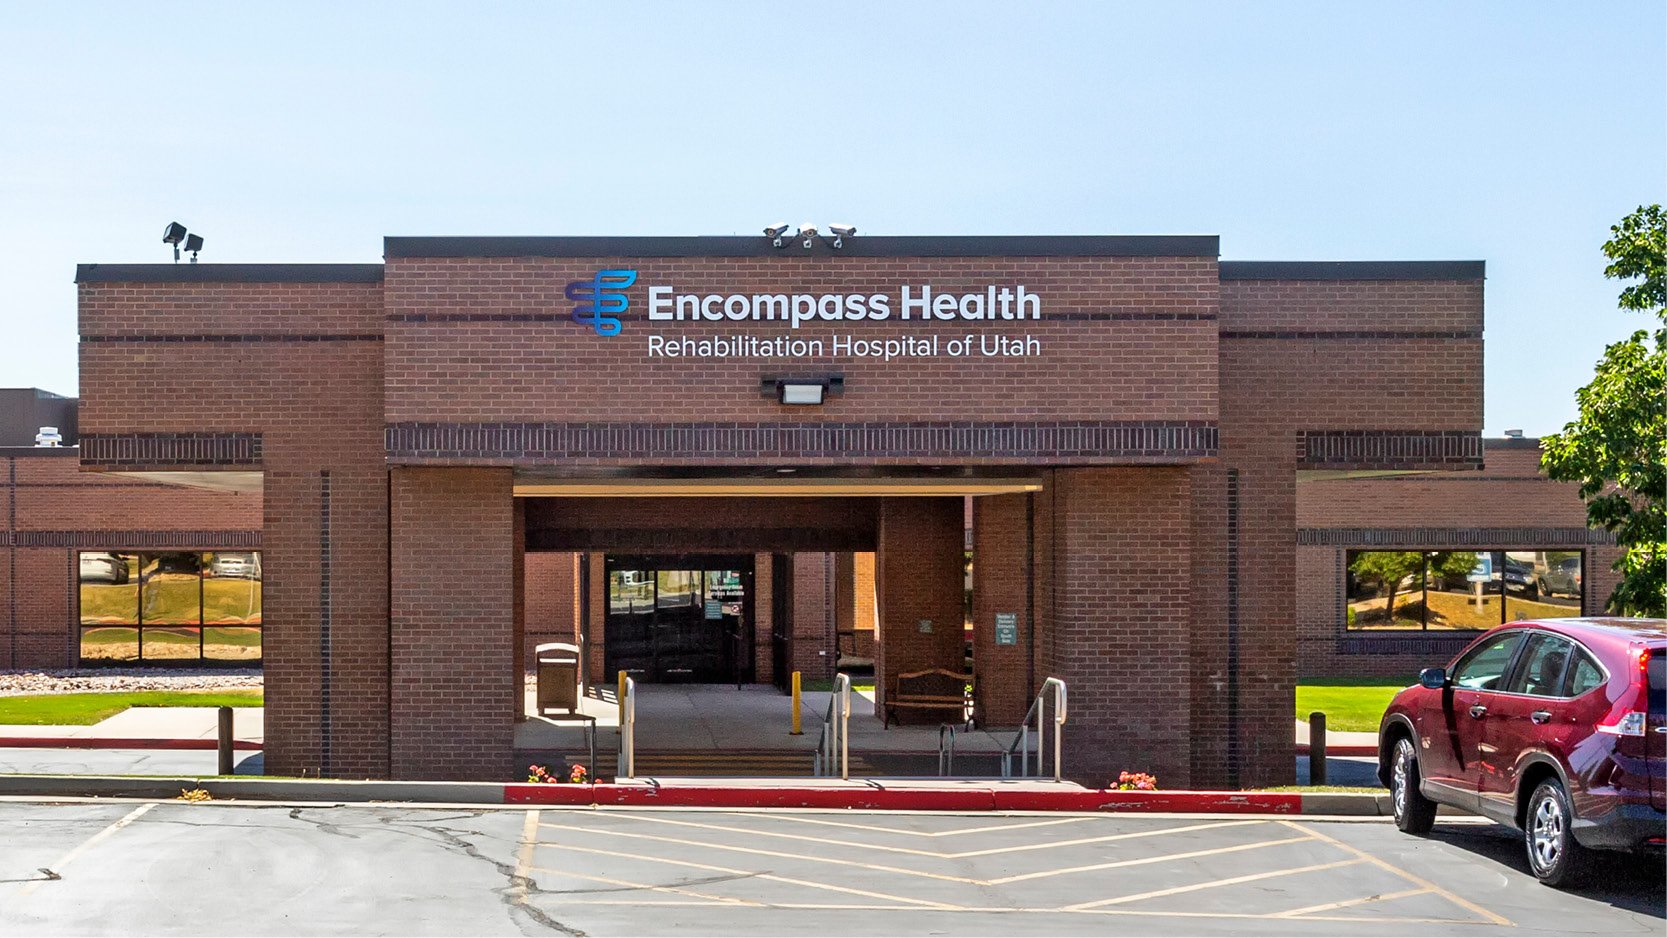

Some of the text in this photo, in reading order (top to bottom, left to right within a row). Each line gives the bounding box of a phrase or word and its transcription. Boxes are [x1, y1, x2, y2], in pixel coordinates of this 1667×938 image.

[648, 285, 1041, 328] Encompass Health
[648, 334, 1040, 362] Rehabilitation Hospital of Utah
